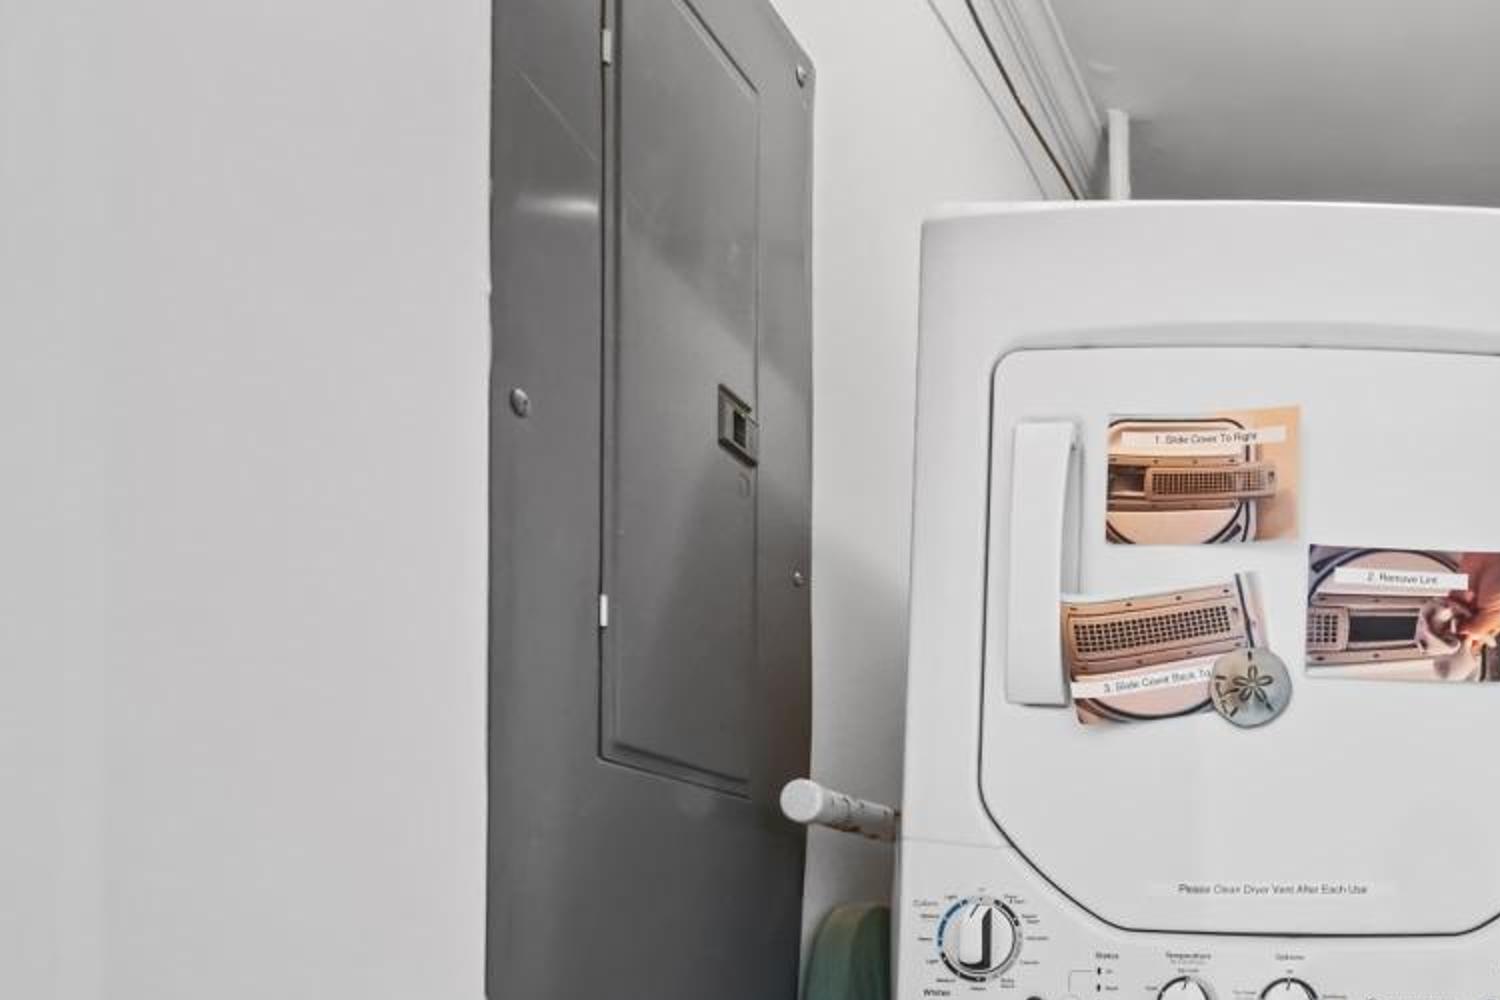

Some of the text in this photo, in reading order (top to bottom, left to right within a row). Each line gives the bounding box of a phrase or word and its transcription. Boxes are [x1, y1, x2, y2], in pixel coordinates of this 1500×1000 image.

[1220, 433, 1231, 443] To
[1234, 432, 1257, 443] Right
[1380, 572, 1418, 584] Remove
[1178, 883, 1368, 896] Please Clean Dryer Vent After Each Use
[1165, 951, 1211, 961] Temperature
[923, 988, 951, 997] Whites
